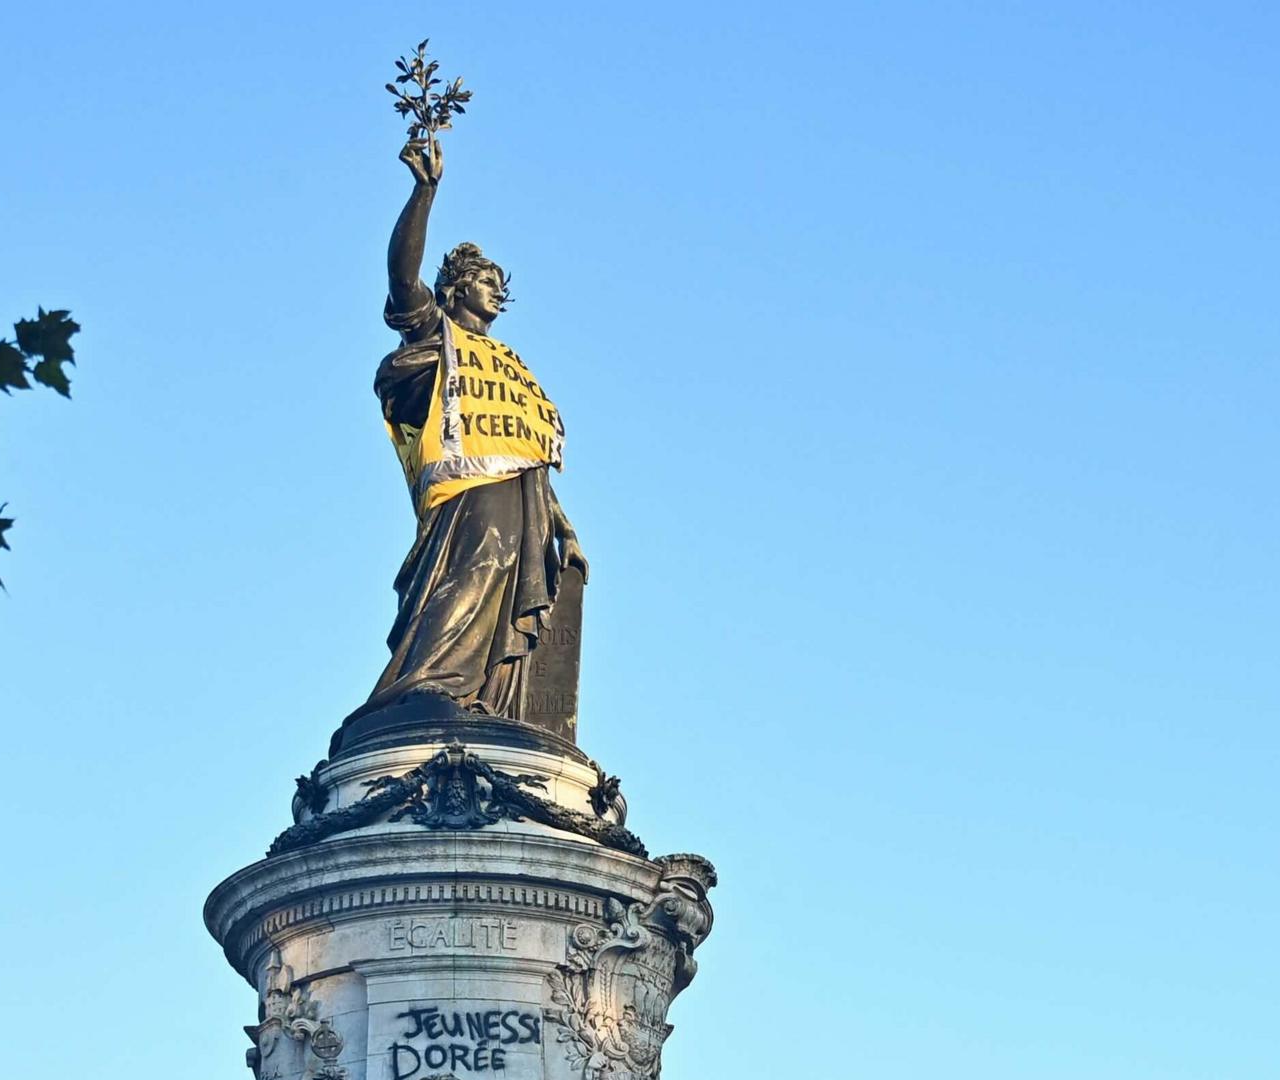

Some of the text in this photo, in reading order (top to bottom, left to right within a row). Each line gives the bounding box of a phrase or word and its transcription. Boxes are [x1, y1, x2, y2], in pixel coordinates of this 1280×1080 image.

[456, 348, 483, 370] LA
[449, 376, 527, 408] MUTILE
[389, 919, 517, 951] ÉGALITÉ
[389, 1041, 506, 1080] DORÉE
